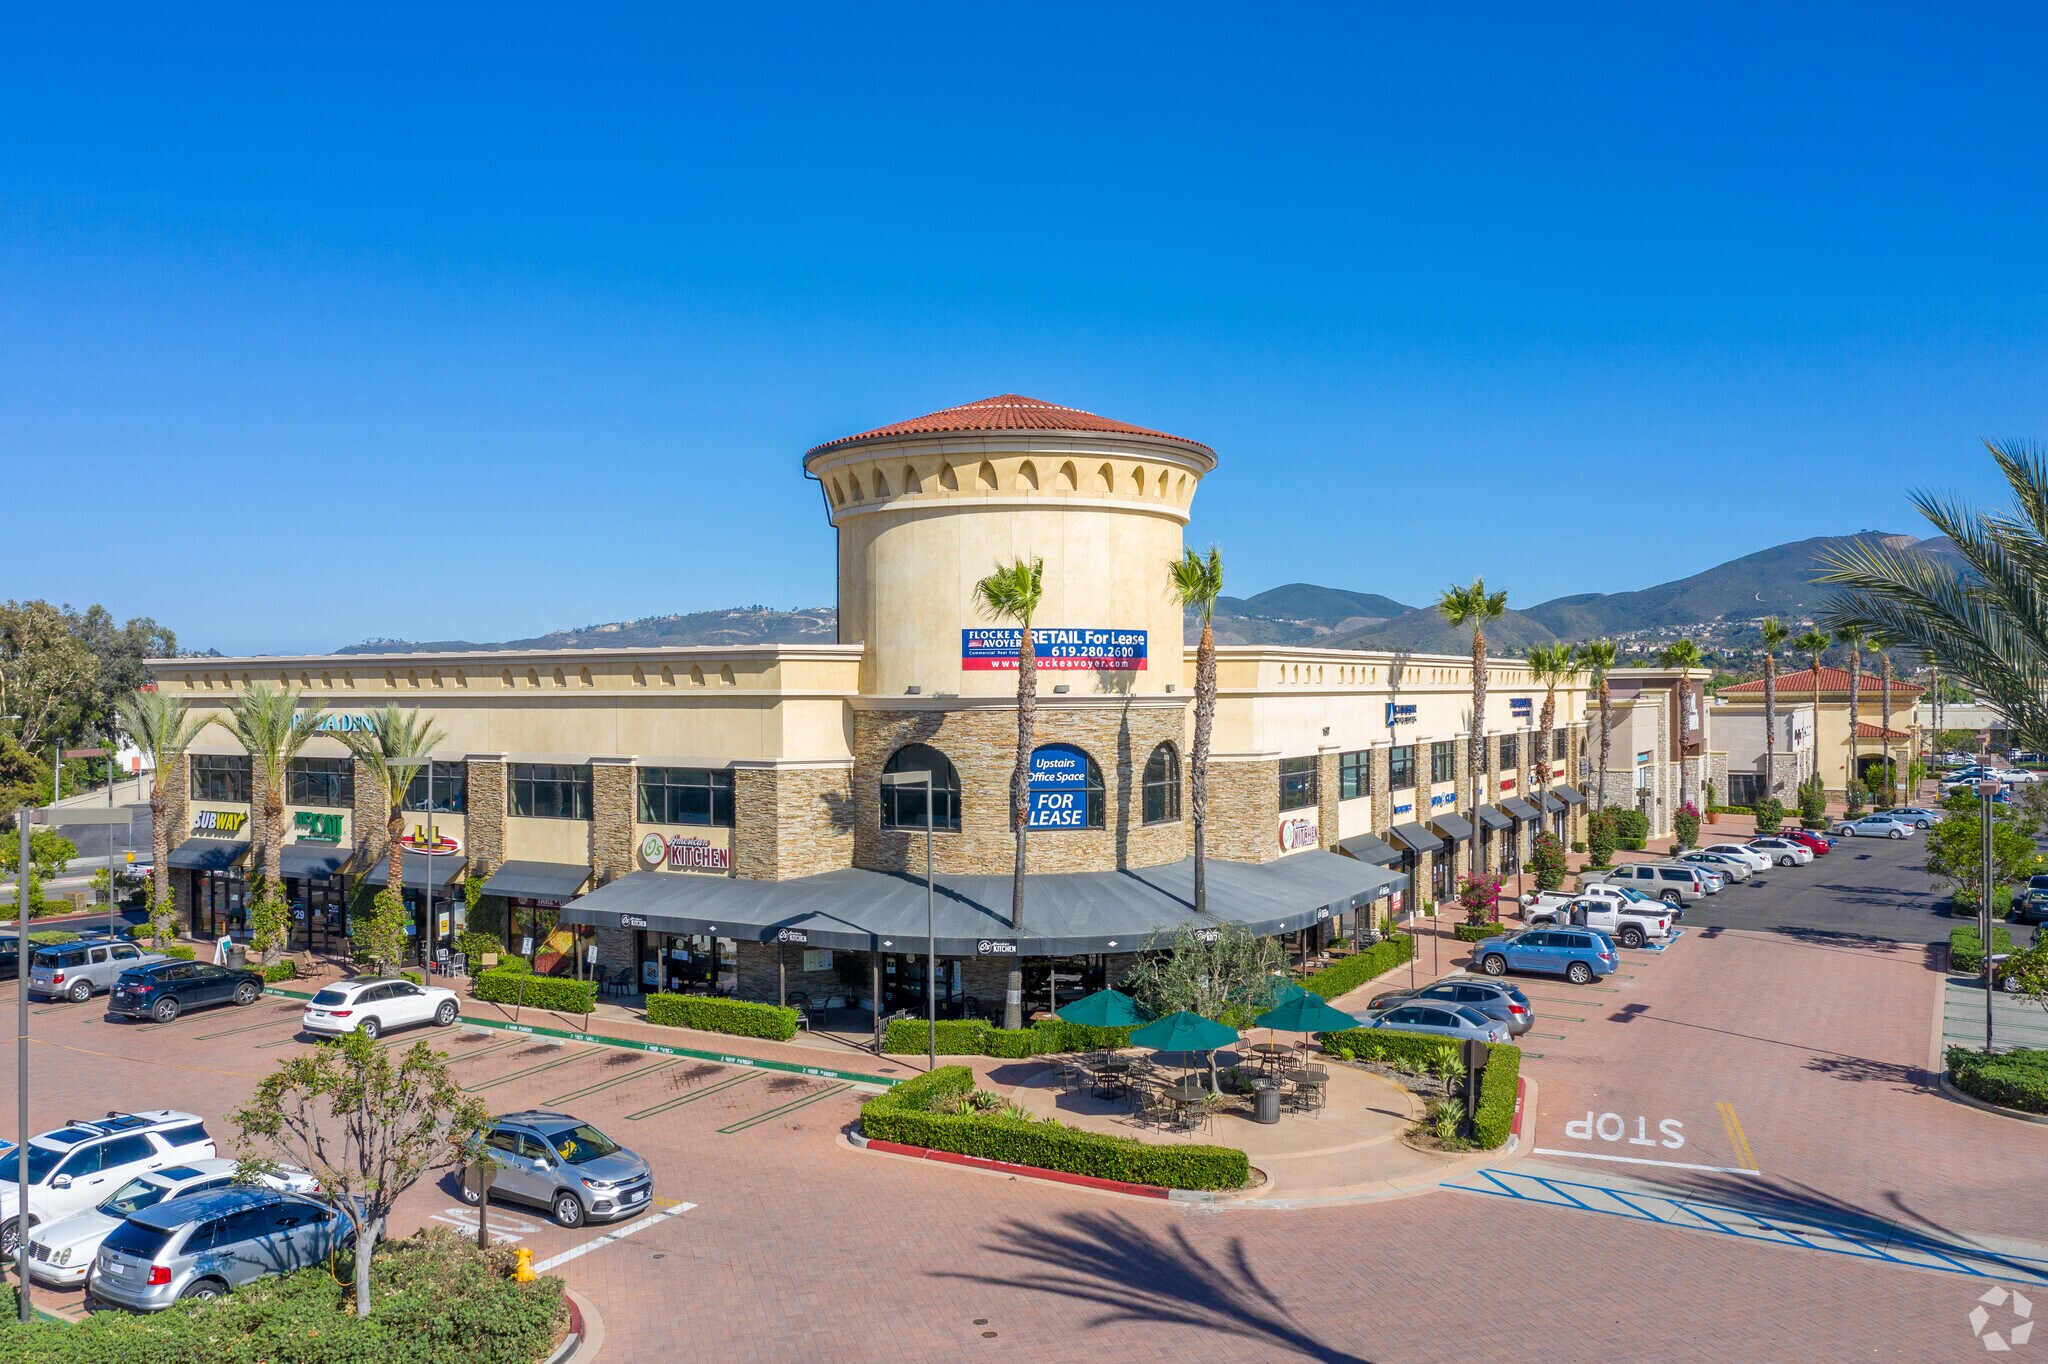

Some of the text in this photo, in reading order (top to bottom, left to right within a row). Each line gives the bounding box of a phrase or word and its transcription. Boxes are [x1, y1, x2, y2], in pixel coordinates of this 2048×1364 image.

[969, 630, 1022, 639] FLOCKE &
[1031, 630, 1144, 645] RETAIL For Lease
[983, 639, 1022, 648] AVOYER
[1051, 646, 1134, 657] 619.280.2600
[1036, 758, 1075, 770] Upstairs
[1028, 772, 1085, 783] Office Space
[1037, 793, 1074, 809] FOR
[193, 812, 245, 830] SUBWAY
[1029, 810, 1083, 826] LEASE
[670, 846, 730, 868] KITCHEN
[1565, 1111, 1686, 1149] STOP
